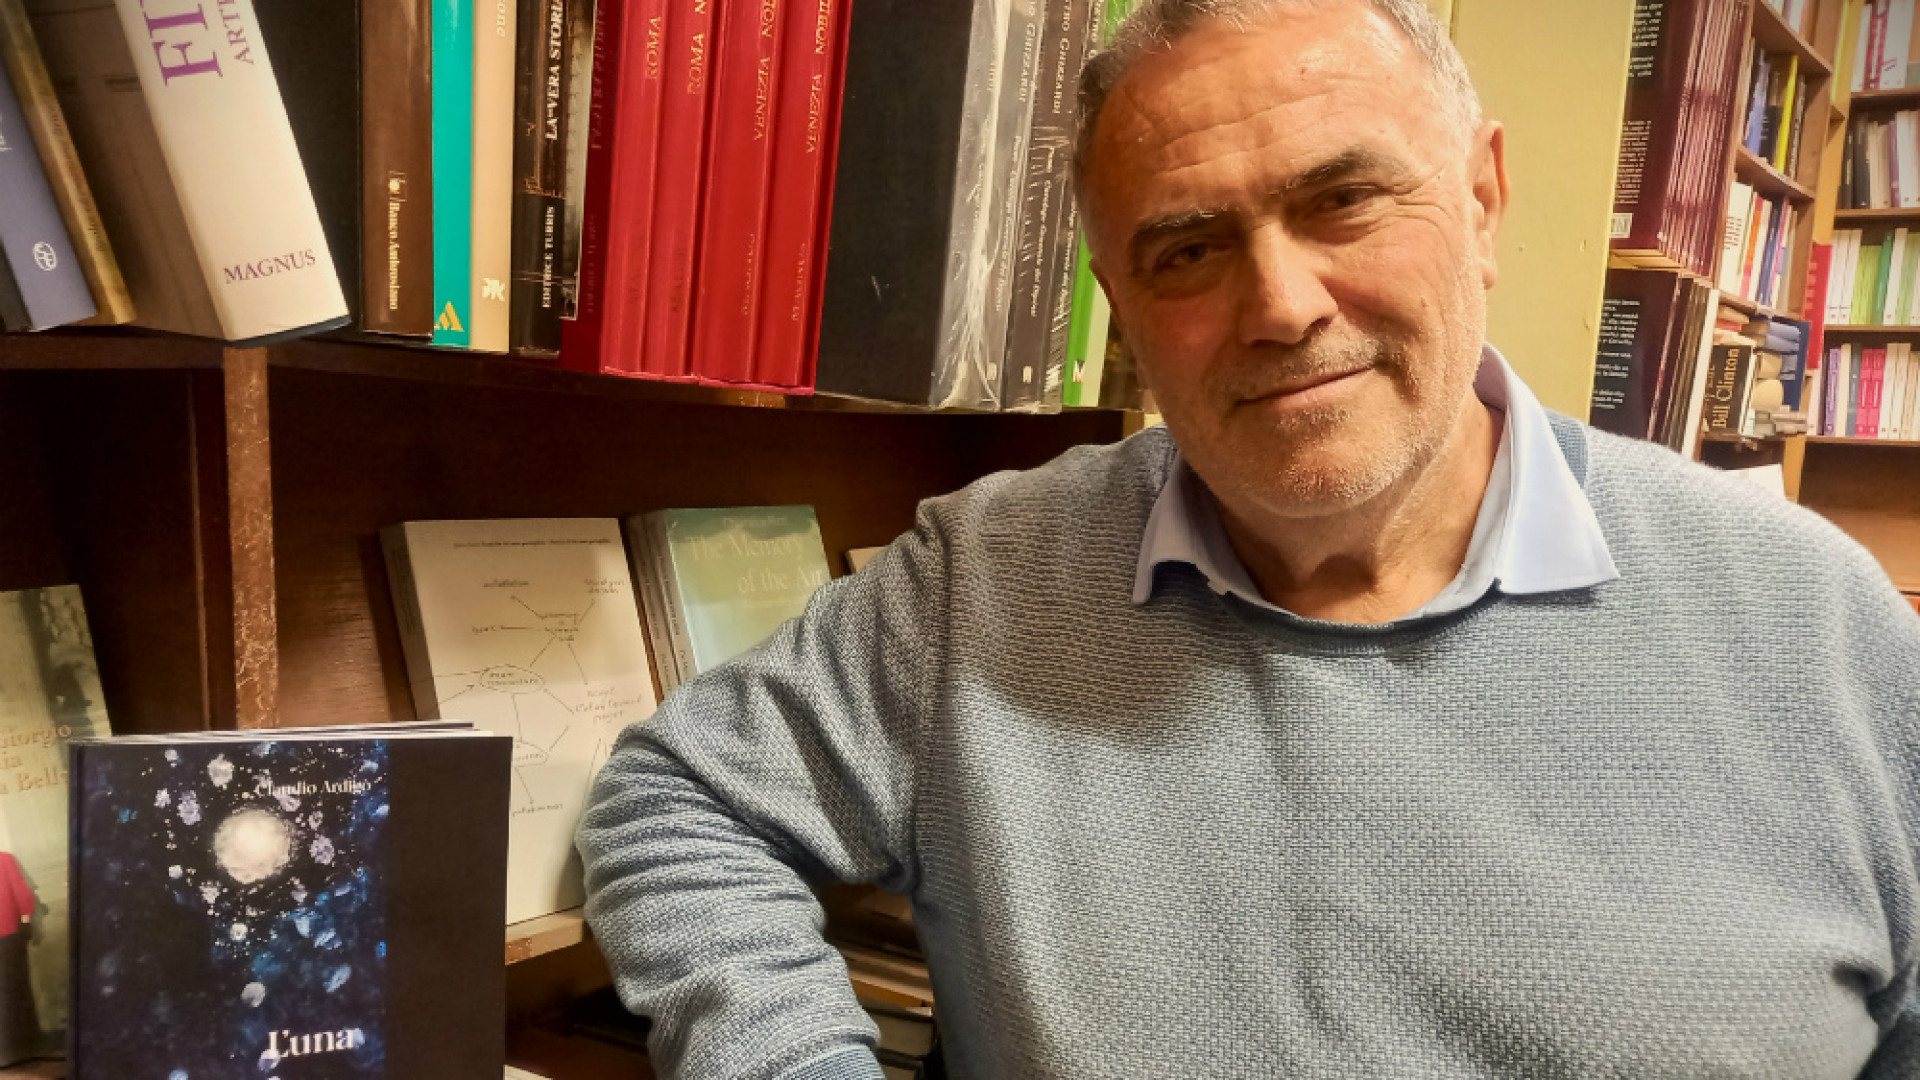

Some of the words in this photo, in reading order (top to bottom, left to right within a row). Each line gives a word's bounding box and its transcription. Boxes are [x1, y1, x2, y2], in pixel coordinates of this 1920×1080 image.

[496, 0, 506, 37] one
[139, 0, 224, 87] FI
[645, 16, 661, 79] ROMA
[687, 33, 705, 95] ROMA
[546, 65, 560, 111] VERA
[754, 57, 771, 140] VENEZIA
[545, 119, 558, 140] LA
[805, 74, 823, 153] VENEZIA
[389, 202, 401, 239] Banco
[545, 206, 555, 249] TURRIS
[224, 249, 316, 284] MAGNUS
[389, 242, 401, 310] Ambrosiano
[542, 253, 553, 308] EDITRICE
[1715, 348, 1740, 402] Clinton
[1712, 405, 1730, 428] Bill
[689, 535, 722, 560] The
[728, 534, 803, 560] Memory
[737, 566, 756, 593] of
[760, 566, 789, 591] the
[254, 780, 317, 796] Claudio
